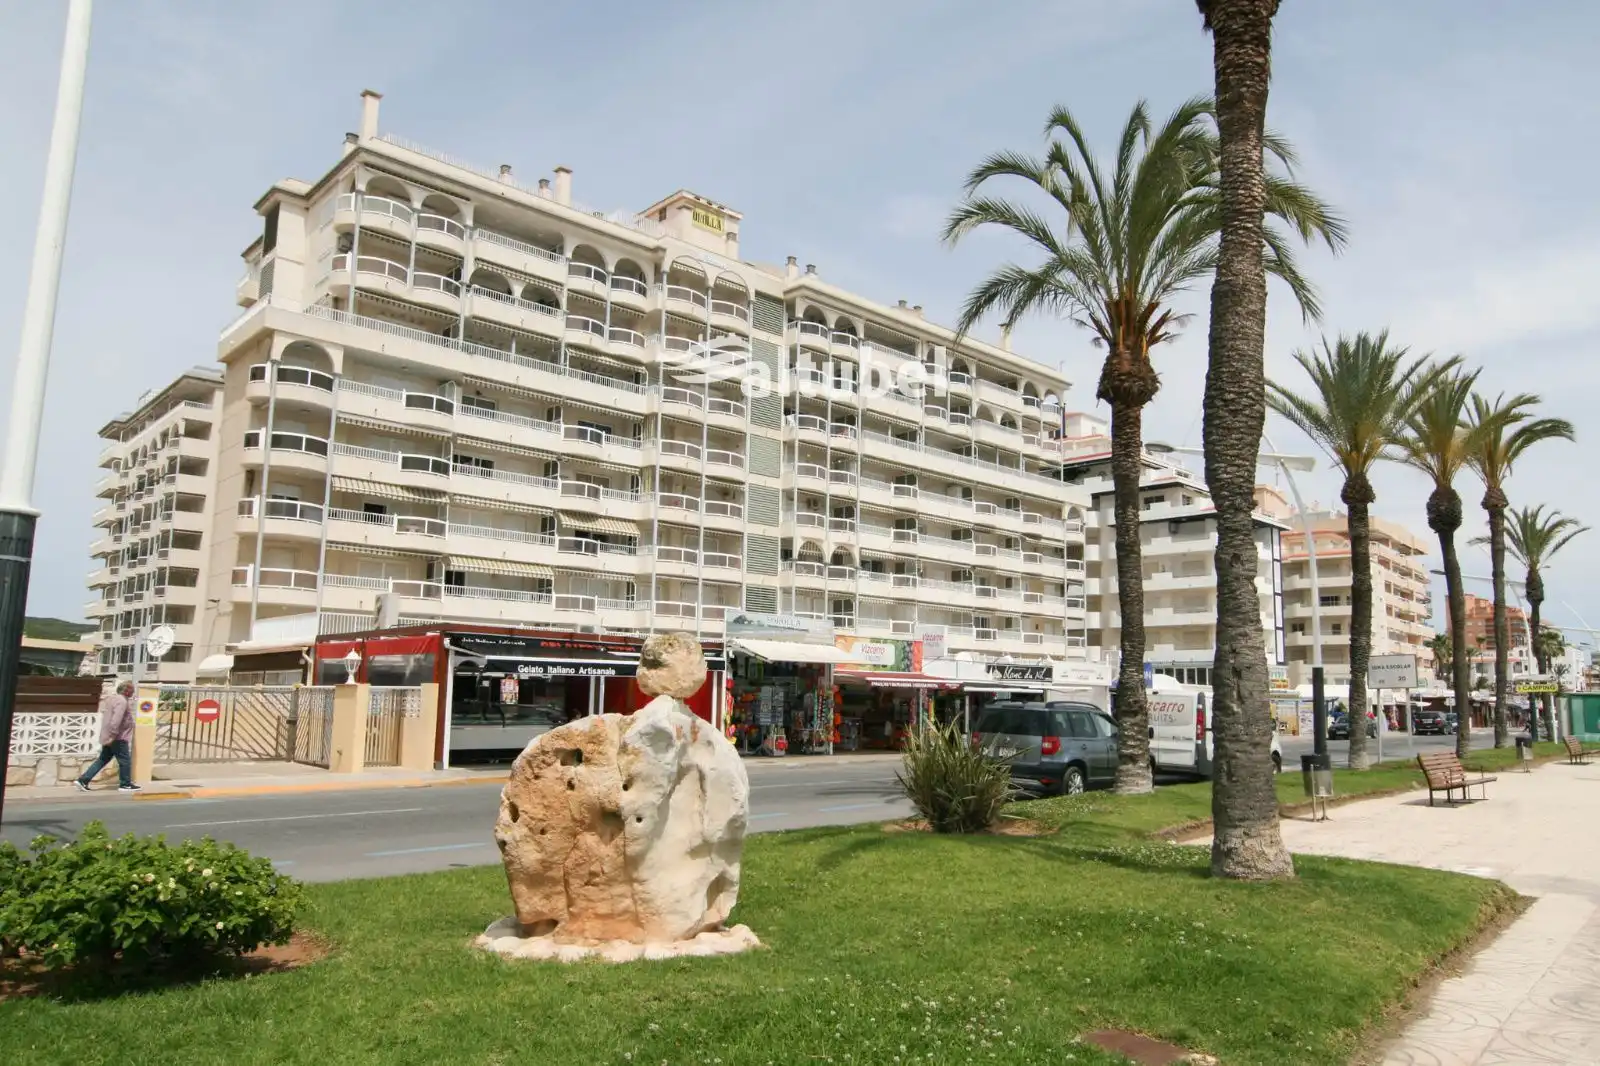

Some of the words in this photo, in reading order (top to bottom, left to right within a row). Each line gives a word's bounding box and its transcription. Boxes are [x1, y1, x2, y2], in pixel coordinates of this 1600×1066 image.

[517, 664, 544, 674] Gelato
[547, 665, 576, 675] Italiano
[578, 667, 616, 676] Artisanale
[1522, 683, 1556, 691] CAMPING
[1146, 701, 1185, 713] zcarro
